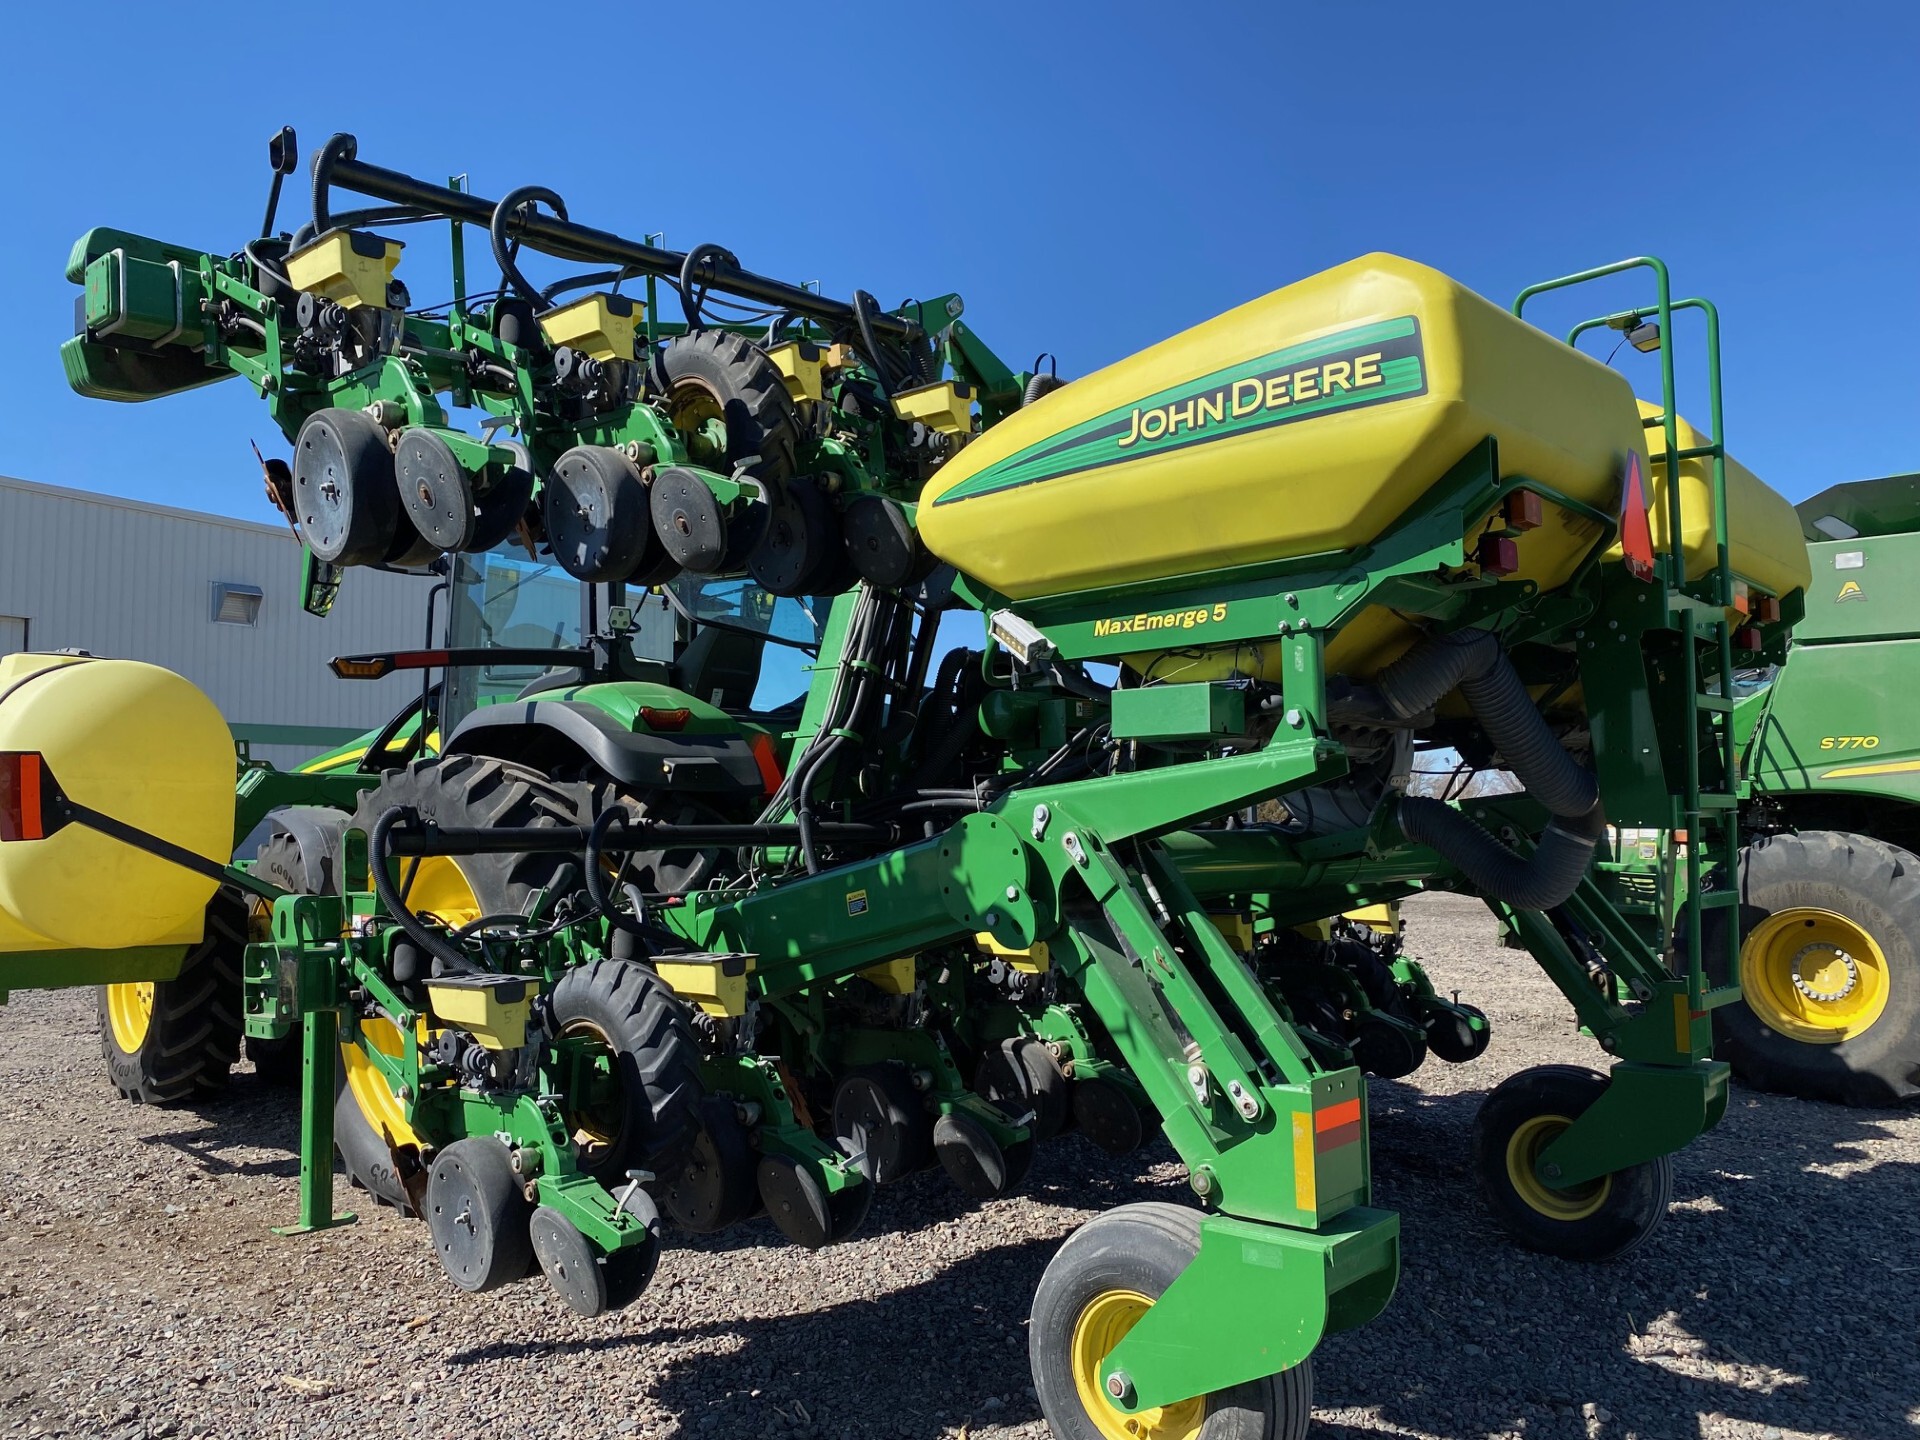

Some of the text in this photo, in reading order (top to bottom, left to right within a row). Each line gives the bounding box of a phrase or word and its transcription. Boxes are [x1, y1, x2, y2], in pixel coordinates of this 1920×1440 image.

[1118, 352, 1385, 448] JOHN DEERE
[1093, 602, 1227, 637] MaxEmerge 5
